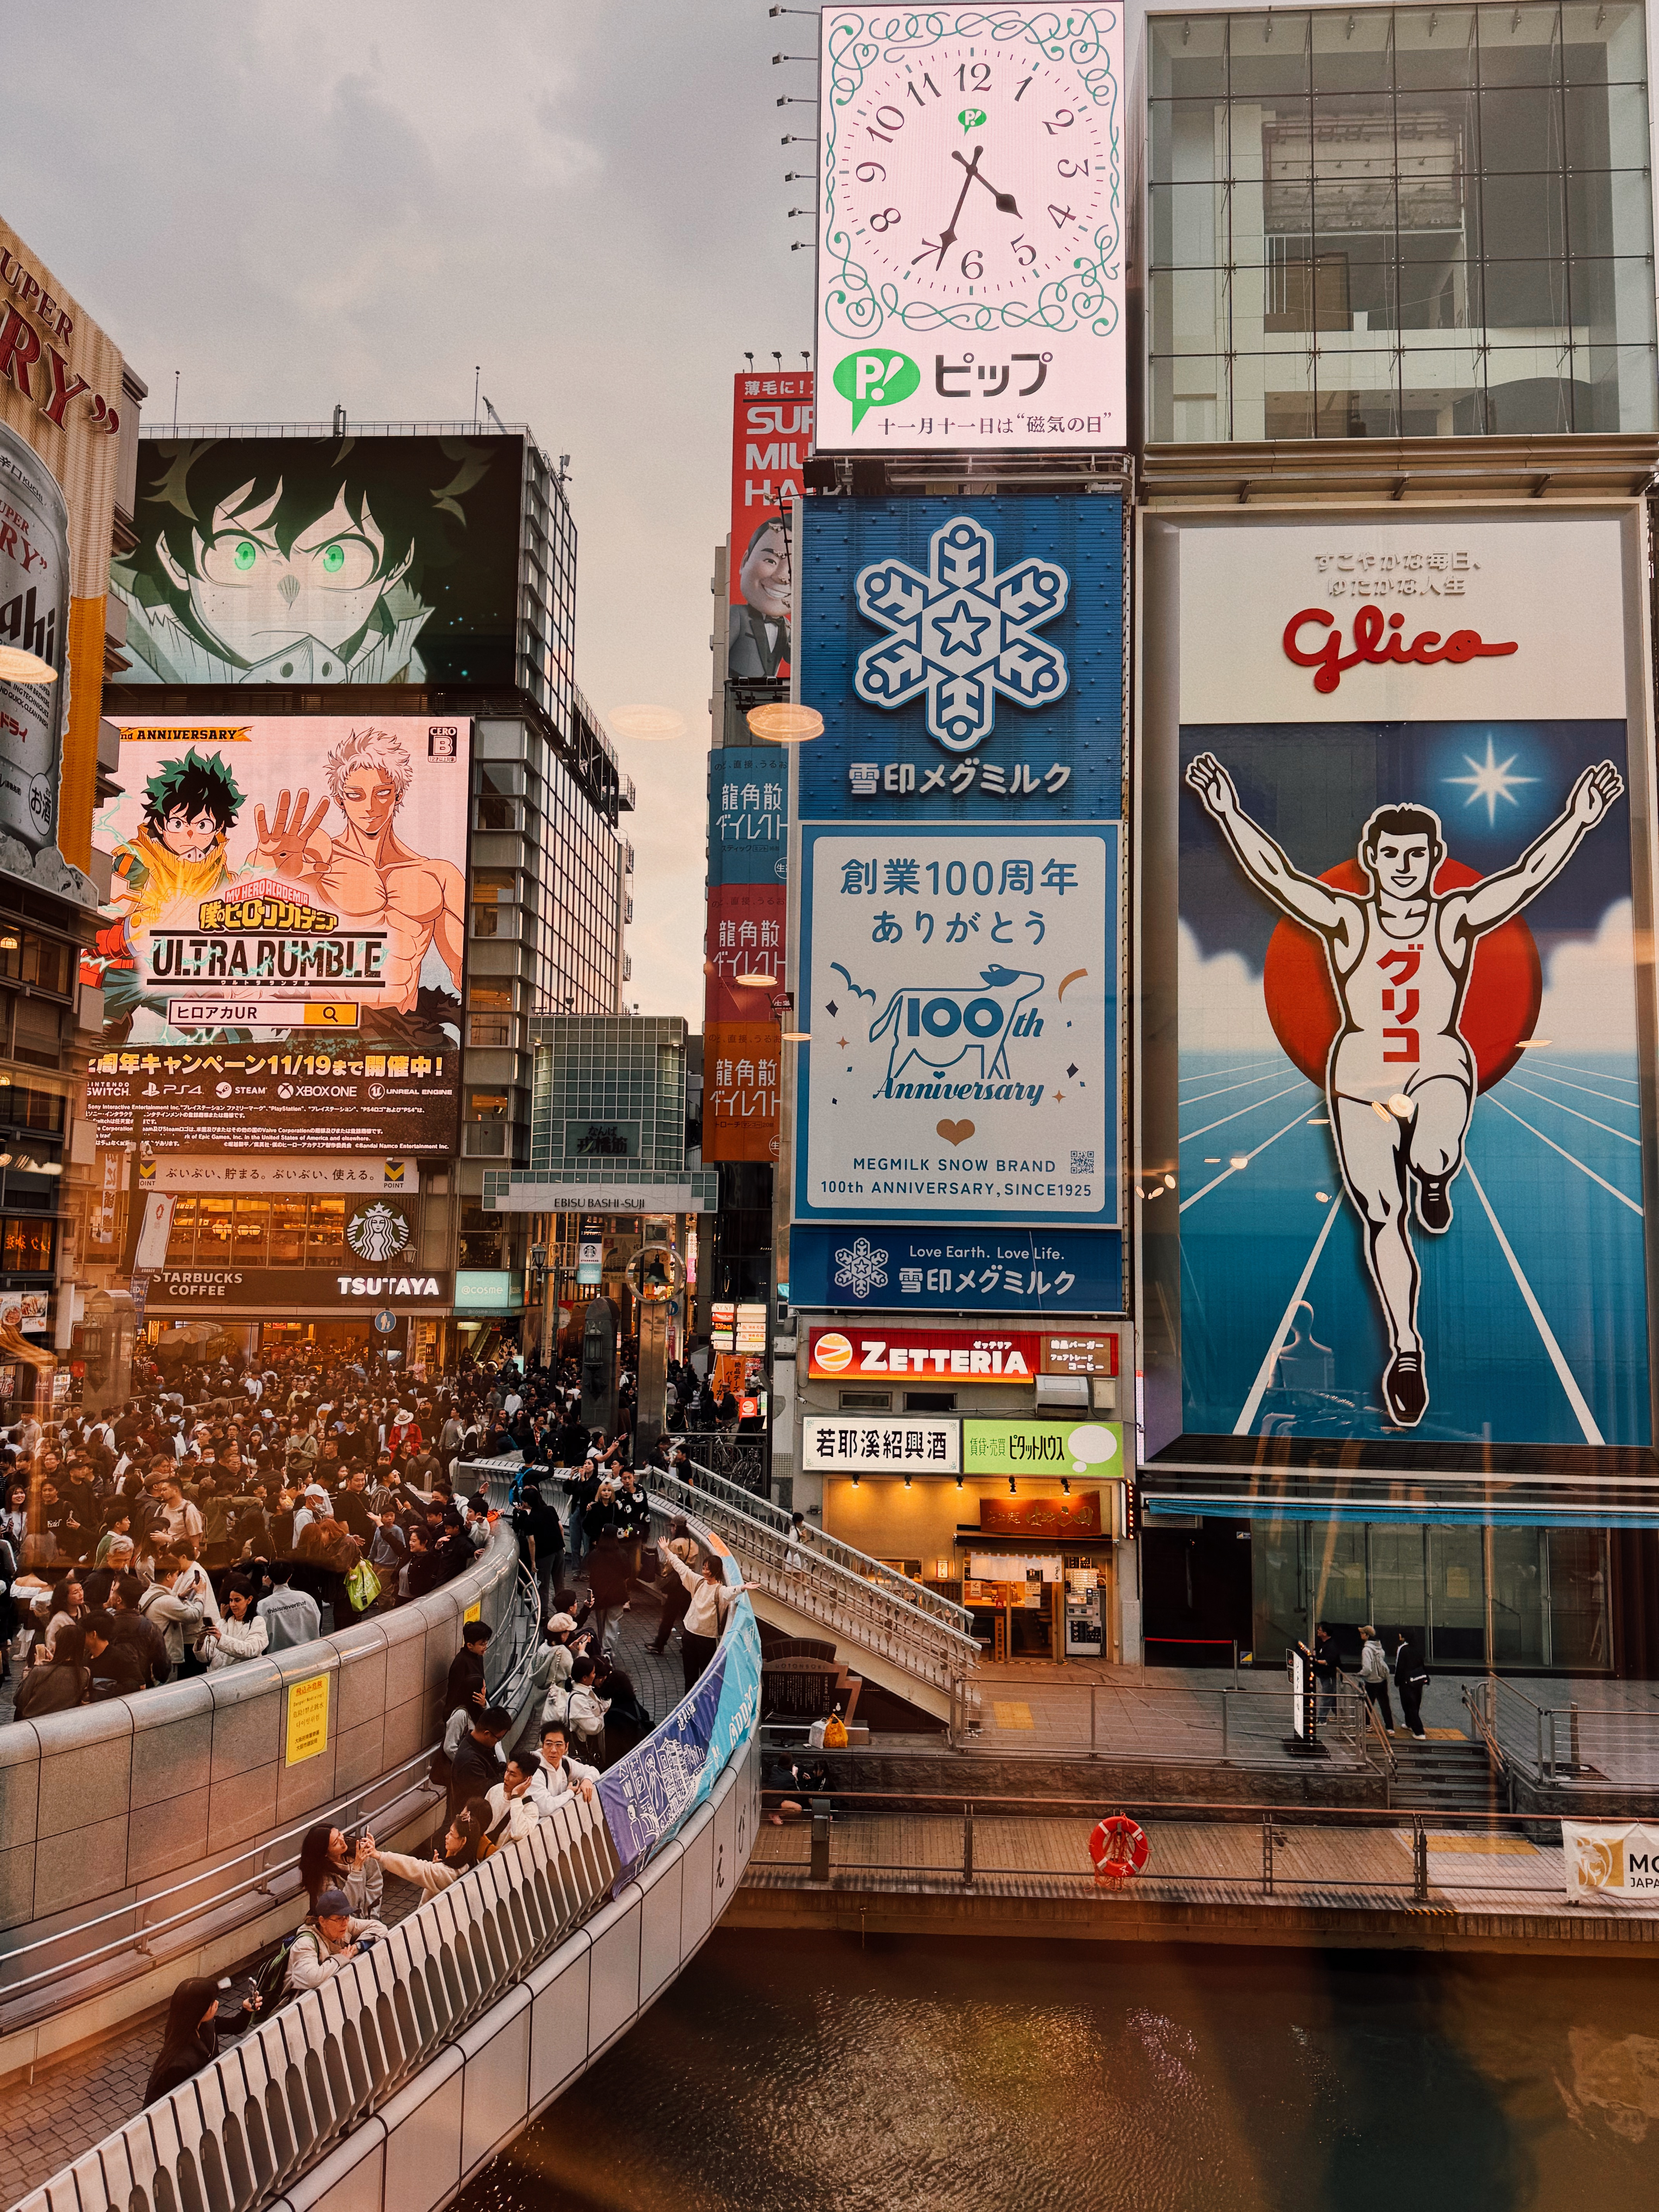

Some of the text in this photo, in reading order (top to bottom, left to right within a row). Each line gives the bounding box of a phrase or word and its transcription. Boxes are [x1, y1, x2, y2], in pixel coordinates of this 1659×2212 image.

[907, 73, 942, 106] 11
[953, 63, 992, 91] 12
[1016, 76, 1033, 101] 1
[866, 106, 905, 143] 10
[1043, 109, 1074, 135] 2
[856, 162, 886, 182] 9
[1058, 159, 1089, 178] 3
[870, 208, 901, 232] 8
[1048, 204, 1076, 228] 4
[912, 238, 942, 265] 7
[1011, 234, 1036, 266] 5
[961, 250, 983, 280] 6
[936, 352, 1053, 397] ピップ
[23, 476, 43, 502] KUCHI
[1315, 550, 1482, 571] すこやかな毎日、
[1328, 575, 1467, 596] ゆたかな人生
[1283, 605, 1518, 693] Glico
[0, 711, 28, 743] ドライ
[138, 730, 237, 740] ANNIVERSARY
[433, 736, 453, 755] B
[849, 758, 1071, 794] 雪印メグミルク
[722, 783, 782, 811] 龍角散
[716, 814, 788, 841] ダイレクト
[776, 863, 787, 872] 生
[841, 859, 1078, 896] 創業100周年
[227, 879, 309, 905] MY HERO ACADEMIA
[719, 920, 780, 947] 龍角散
[872, 910, 1046, 945] ありがとう
[153, 939, 381, 978] ULTRA RUMBLE
[713, 951, 786, 977] ダイレクト
[177, 1005, 258, 1020] ヒロアカUR
[1376, 944, 1424, 1062] グリコ
[716, 1058, 776, 1086] 龍角散
[295, 1085, 329, 1097] XBOX
[331, 1086, 357, 1097] ONE
[709, 1090, 781, 1116] ダイレクト
[873, 1077, 1044, 1106] Anniversary
[588, 1126, 617, 1136] なんば
[853, 1158, 1056, 1173] MEGMILK SNOW BRAND
[821, 1181, 864, 1194] 100th
[554, 1198, 585, 1208] EBISU
[910, 1245, 1065, 1260] Love Earth. Love Life.
[153, 1272, 243, 1284] STARBUCKS
[169, 1285, 225, 1296] COFFEE
[337, 1277, 440, 1296] TSUTAYA
[461, 1285, 503, 1295] @cosme
[899, 1265, 1075, 1295] 雪印メグミルク
[860, 1341, 1029, 1375] ZETTERIA
[973, 1340, 1012, 1350] ゼッテリア
[1050, 1354, 1093, 1362] フェアトレード
[1068, 1362, 1104, 1371] コーヒー
[816, 1429, 947, 1460] 若耶溪紹興酒
[970, 1434, 1065, 1461] 賃貸・売買 ピタットハウス
